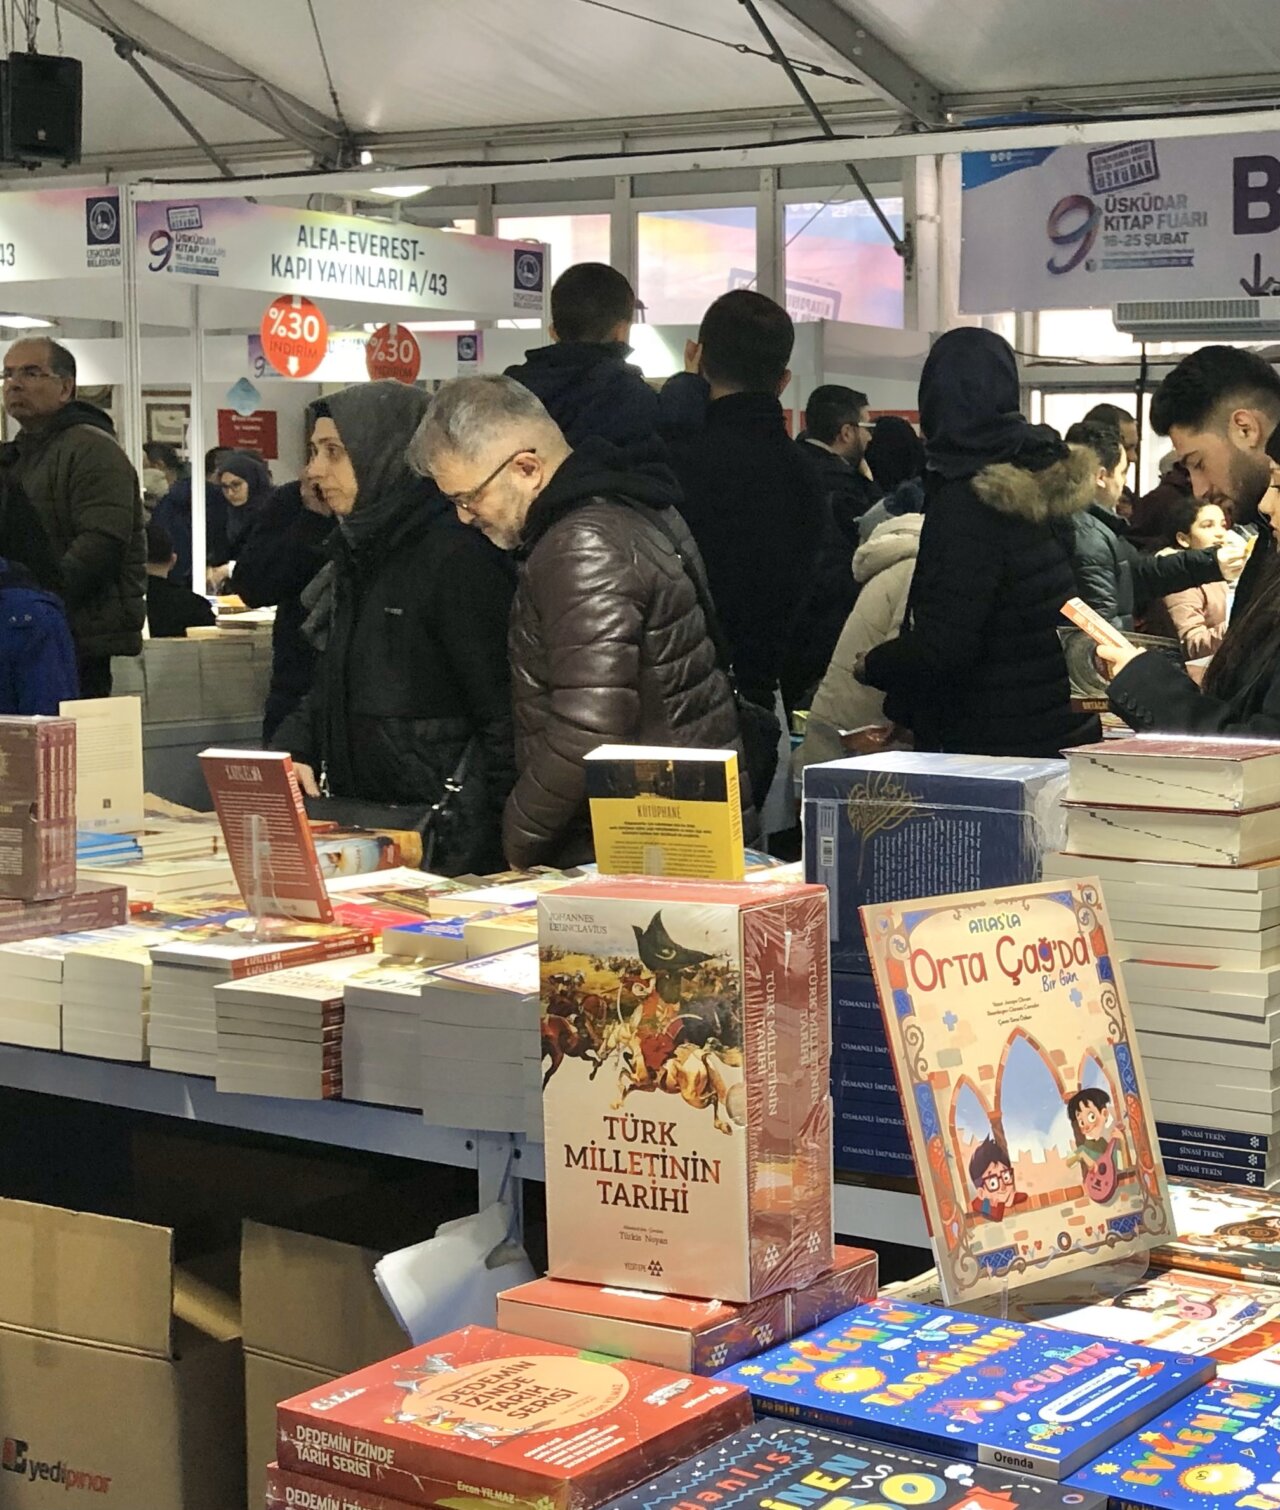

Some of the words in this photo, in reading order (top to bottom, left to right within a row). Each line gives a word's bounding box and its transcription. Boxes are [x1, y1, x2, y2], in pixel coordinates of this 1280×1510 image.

[1104, 192, 1189, 214] ÜSKÜDAR
[1156, 211, 1209, 230] FUARI
[297, 224, 426, 262] ALFA-EVEREST-
[1144, 232, 1190, 248] ŞUBAT
[271, 254, 313, 282] KAPI
[316, 258, 404, 289] YAYINLARI
[407, 271, 449, 296] A/43
[269, 307, 320, 343] %30
[370, 336, 414, 363] %30
[1041, 974, 1057, 993] Bir
[839, 999, 871, 1010] OSMANLI
[841, 1042, 873, 1054] OSMANLI
[841, 1079, 873, 1091] OSMANLI
[842, 1112, 874, 1124] OSMANLI
[603, 1113, 679, 1148] TÜRK
[1204, 1132, 1227, 1141] TEKİN
[563, 1140, 722, 1185] MİLLETİNİN
[842, 1145, 874, 1157] OSMANLI
[1203, 1149, 1225, 1159] TEKİN
[1201, 1167, 1223, 1176] TEKİN
[596, 1179, 690, 1214] TARİHİ
[435, 1358, 538, 1404] DEDEMİN
[458, 1376, 536, 1409] İZİNDE
[481, 1385, 550, 1415] TARİH
[506, 1387, 579, 1421] SERİSİ
[296, 1425, 351, 1454] DEDEMİN
[352, 1439, 395, 1466] İZİNDE
[296, 1443, 331, 1467] TARİH
[332, 1452, 371, 1479] SERİSİ
[993, 1450, 1035, 1471] Orenda
